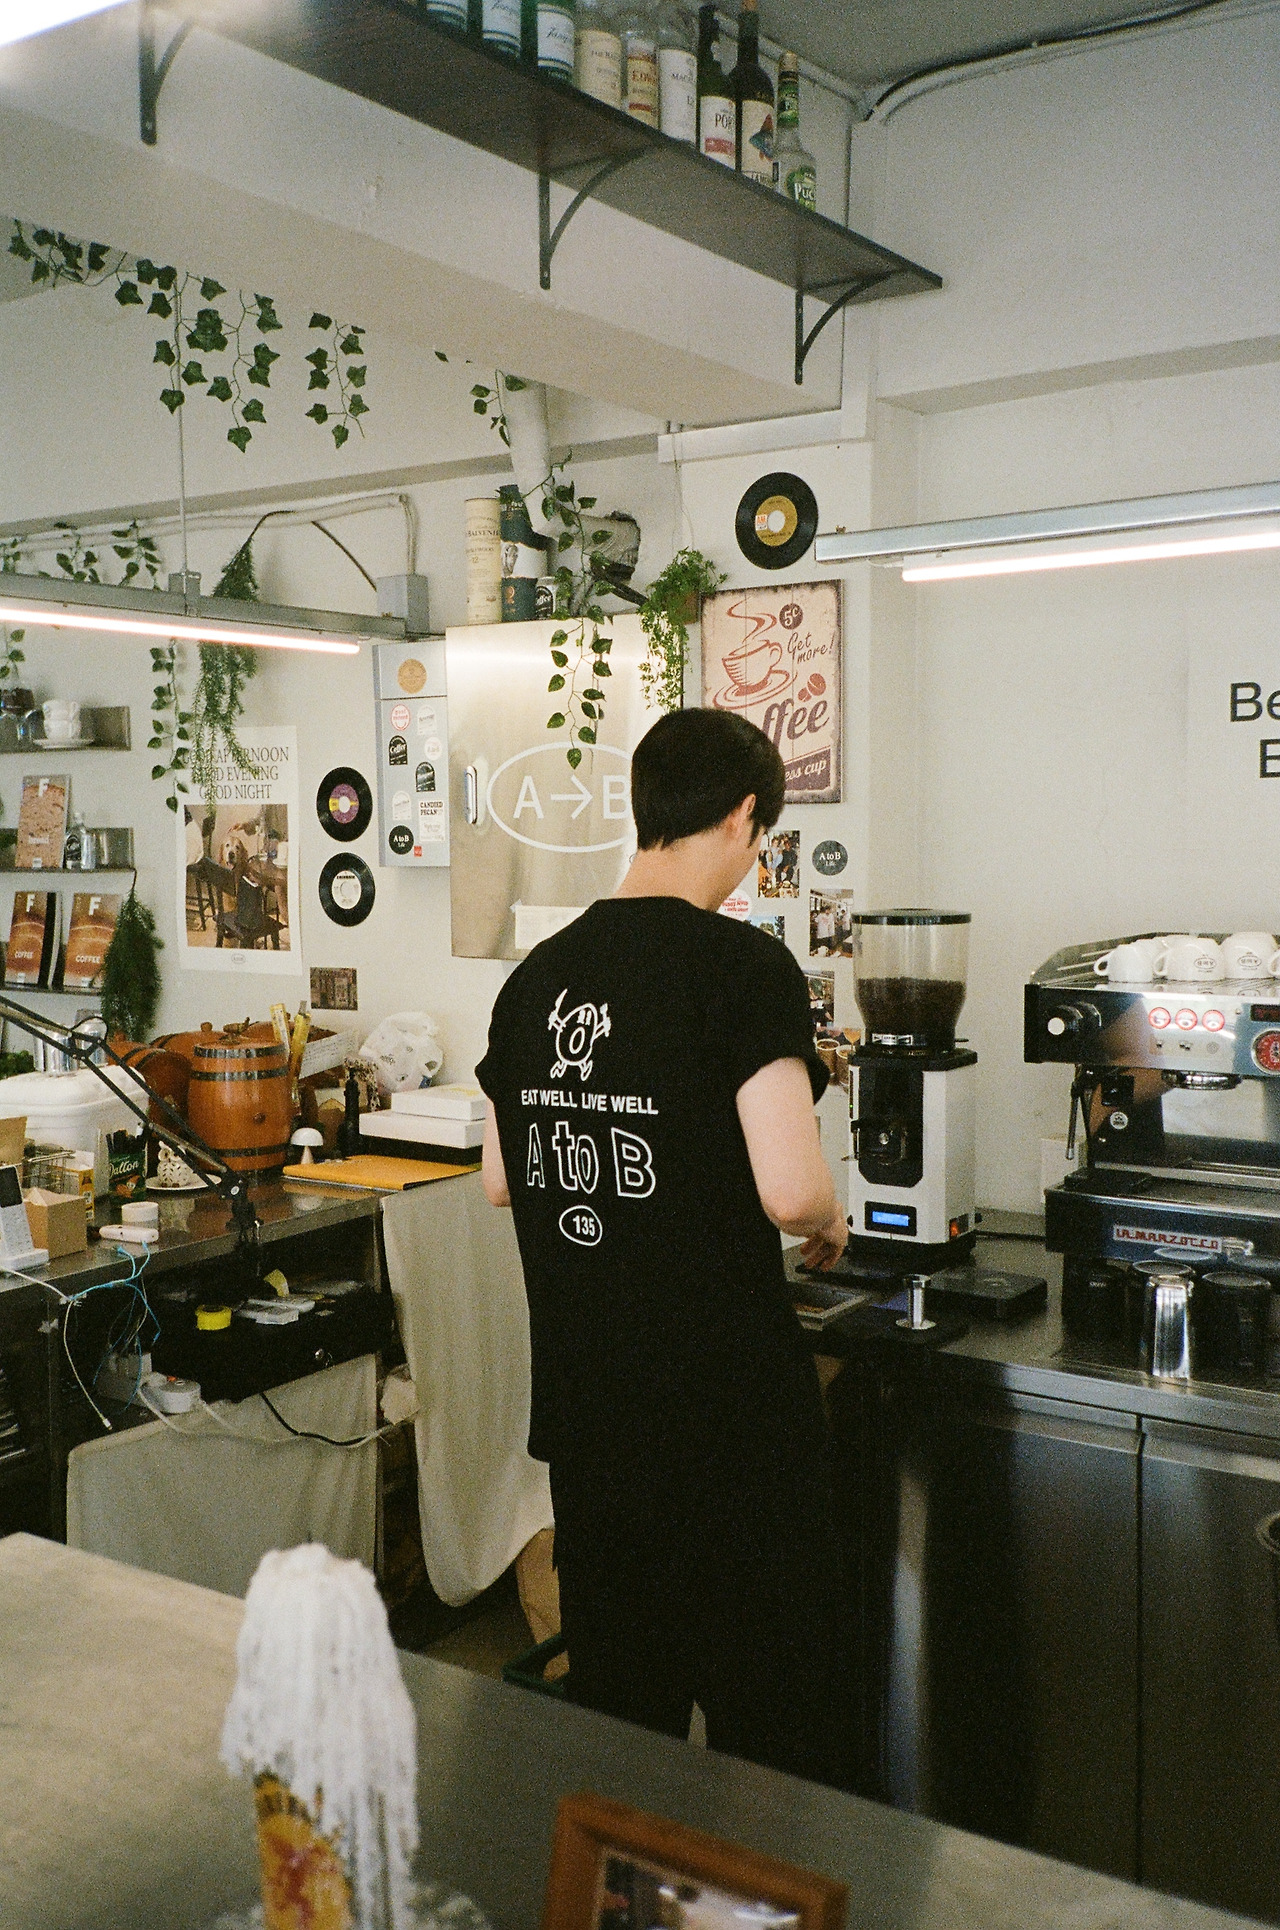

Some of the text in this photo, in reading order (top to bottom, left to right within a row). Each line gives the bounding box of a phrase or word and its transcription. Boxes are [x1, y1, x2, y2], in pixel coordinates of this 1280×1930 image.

[787, 632, 811, 660] Get
[797, 631, 835, 664] more!
[762, 698, 830, 749] ffee
[804, 760, 827, 776] cup
[38, 779, 49, 796] F
[234, 784, 272, 799] NIGHT
[513, 775, 544, 819] A
[819, 852, 826, 861] A
[834, 851, 841, 860] B
[26, 894, 35, 912] F
[89, 896, 101, 915] F
[75, 955, 101, 964] COFFEE
[521, 1089, 659, 1115] EAT WELL LIVE WELL
[527, 1120, 657, 1199] A to B
[572, 1214, 596, 1237] 135
